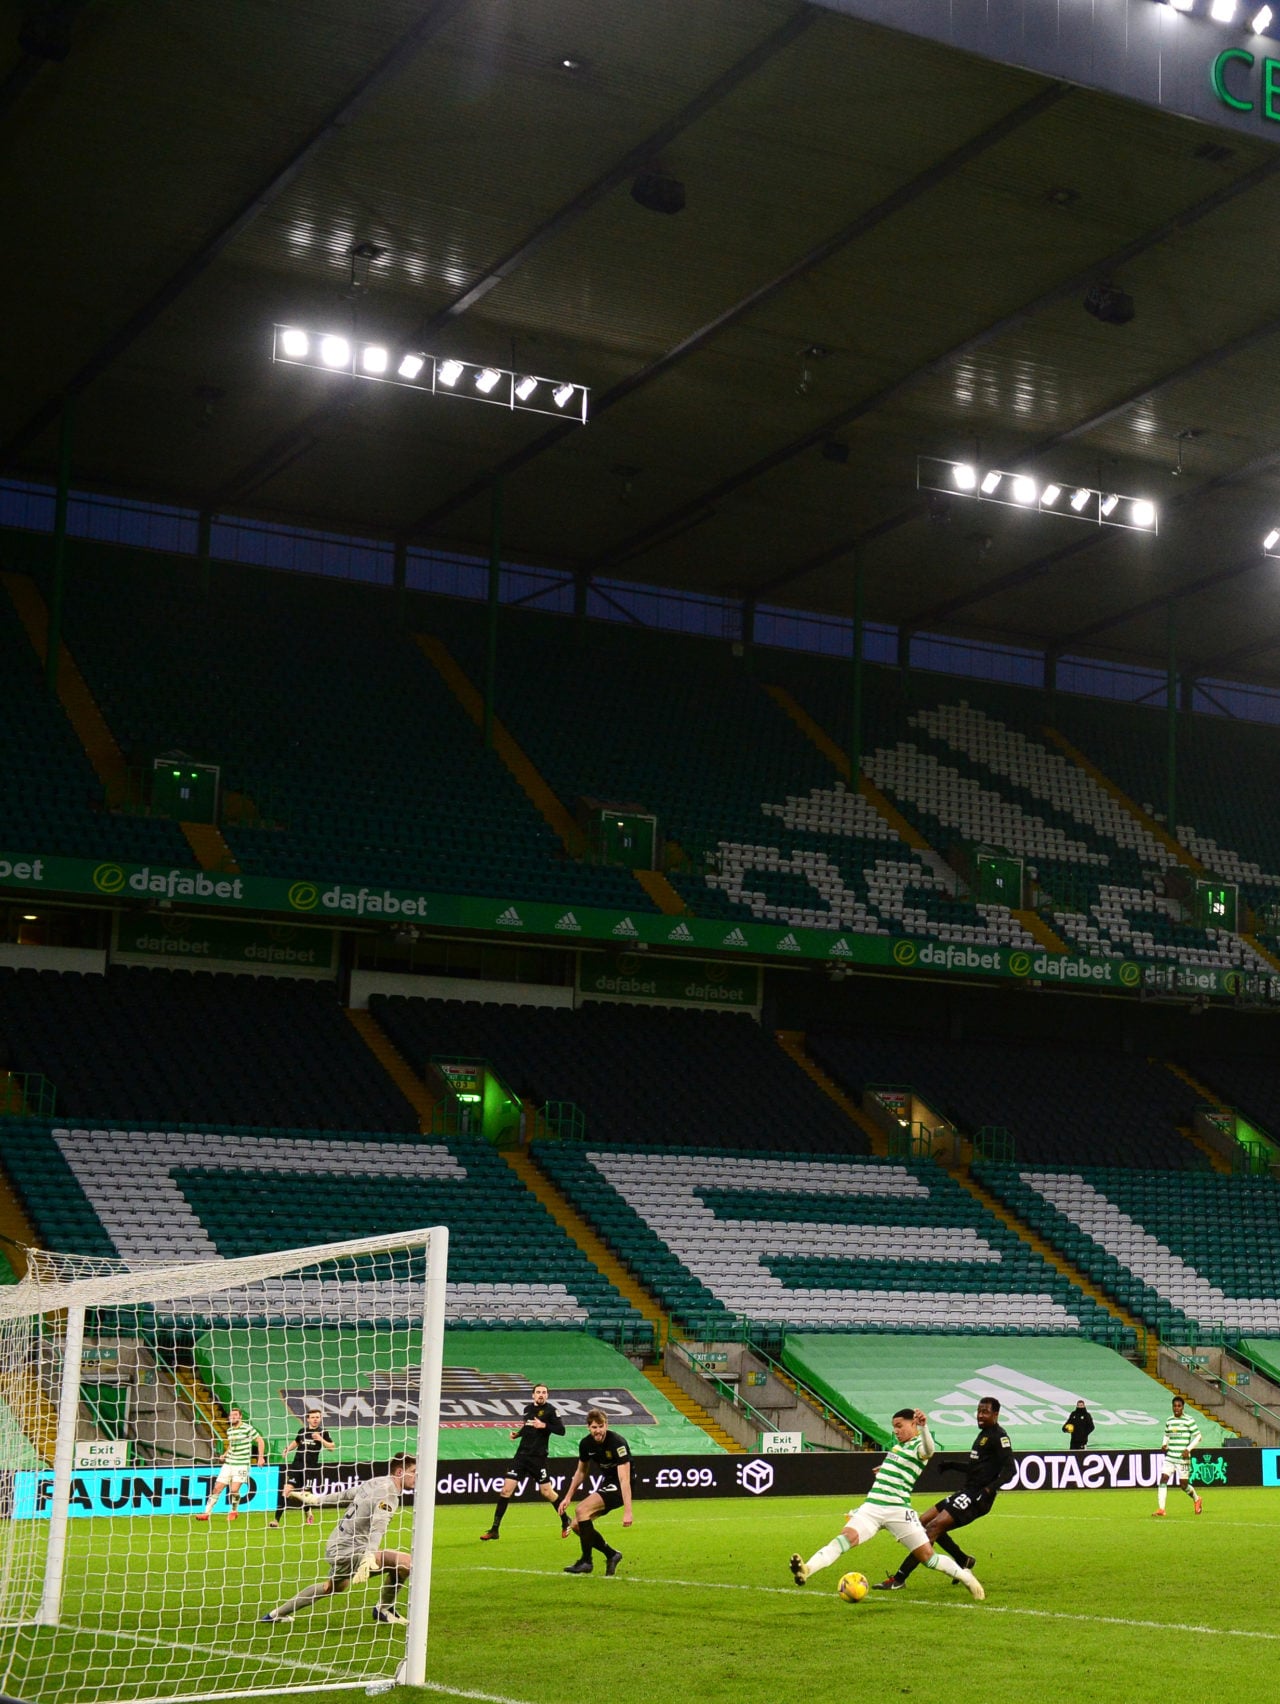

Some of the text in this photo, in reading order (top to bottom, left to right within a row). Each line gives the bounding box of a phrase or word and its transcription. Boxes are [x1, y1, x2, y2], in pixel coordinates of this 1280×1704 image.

[129, 867, 243, 899] dafabet
[321, 885, 427, 916] dafabet
[136, 935, 211, 954] dafabet
[244, 943, 316, 962] dafabet
[919, 943, 1000, 970] dafabet
[1033, 955, 1111, 980] dafabet
[596, 975, 657, 994] dafabet
[685, 983, 744, 1001] dafabet
[773, 1436, 792, 1444] Exit
[90, 1446, 114, 1455] Exit
[81, 1458, 104, 1467] Gate
[437, 1473, 529, 1496] delivey
[655, 1469, 717, 1487] £9.99.
[541, 1469, 547, 1479] 3
[955, 1494, 972, 1510] 25
